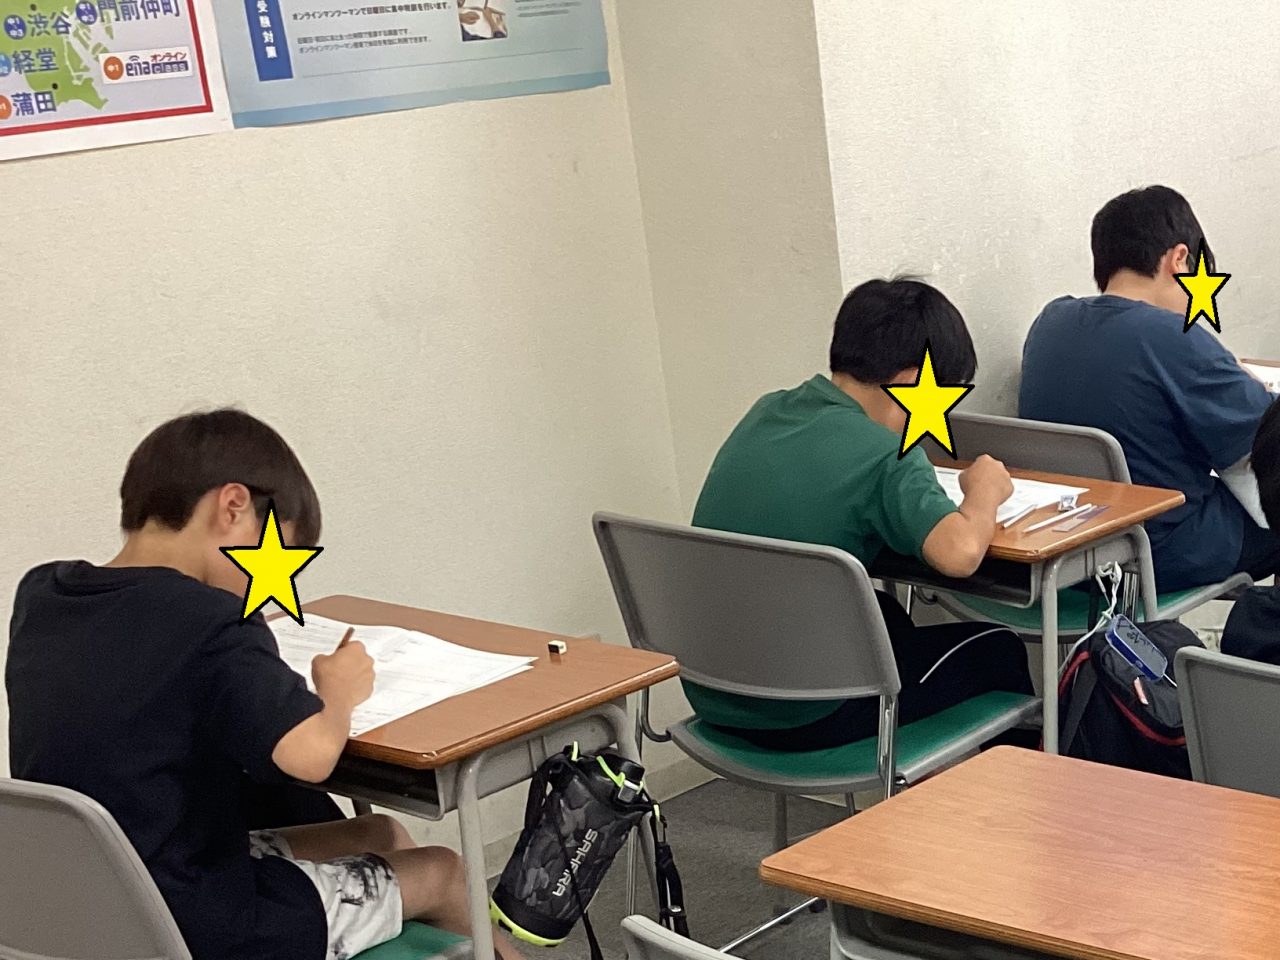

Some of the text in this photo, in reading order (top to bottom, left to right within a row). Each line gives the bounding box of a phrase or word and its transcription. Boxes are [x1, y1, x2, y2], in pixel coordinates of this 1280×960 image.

[97, 0, 180, 22] 門前仲町
[27, 11, 72, 37] 渋谷
[13, 48, 59, 74] 経堂
[126, 61, 151, 76] ena
[150, 52, 187, 62] オンライン
[11, 91, 57, 116] 蒲田
